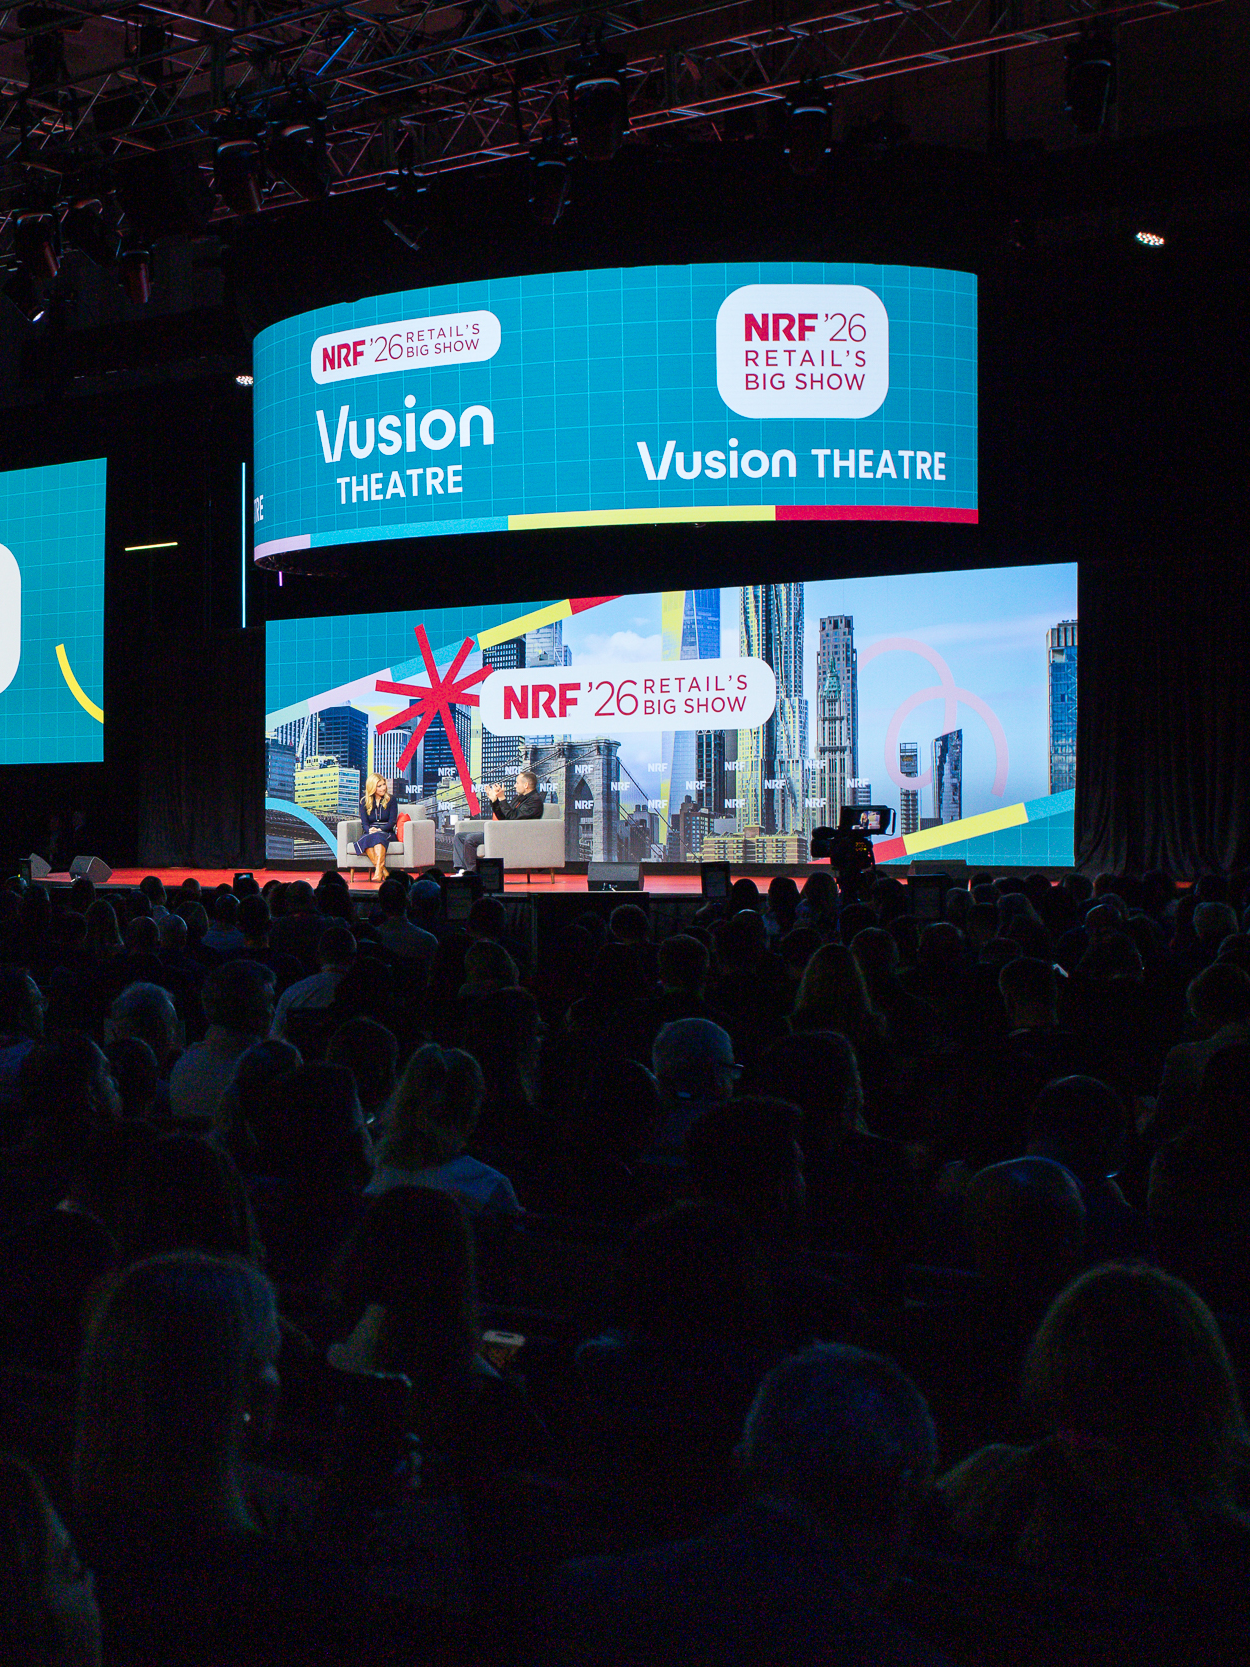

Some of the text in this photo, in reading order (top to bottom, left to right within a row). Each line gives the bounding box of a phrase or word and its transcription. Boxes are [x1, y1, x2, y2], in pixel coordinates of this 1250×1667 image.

[745, 313, 818, 341] NRF
[407, 324, 480, 343] RETAIL’S
[407, 338, 480, 358] BIG SHOW
[323, 340, 366, 372] NRF
[745, 350, 866, 367] RETAIL’S
[745, 373, 866, 390] BIG SHOW
[316, 394, 494, 463] Vusion
[637, 438, 947, 480] Vusion THEATRE
[337, 464, 463, 504] THEATRE
[643, 674, 748, 694] RETAIL’S
[503, 683, 581, 719] NRF
[643, 695, 747, 715] BIG SHOW
[575, 765, 594, 774] NRF
[648, 763, 668, 772] NRF
[724, 762, 746, 771] NRF
[805, 760, 827, 769] NRF
[438, 767, 456, 776] NRF
[540, 783, 558, 792] NRF
[611, 782, 630, 791] NRF
[686, 781, 706, 790] NRF
[764, 780, 786, 789] NRF
[847, 778, 870, 788] NRF
[405, 785, 423, 794] NRF
[438, 801, 456, 810] NRF
[575, 800, 594, 809] NRF
[648, 799, 668, 809] NRF
[724, 799, 746, 808] NRF
[805, 798, 827, 808] NRF
